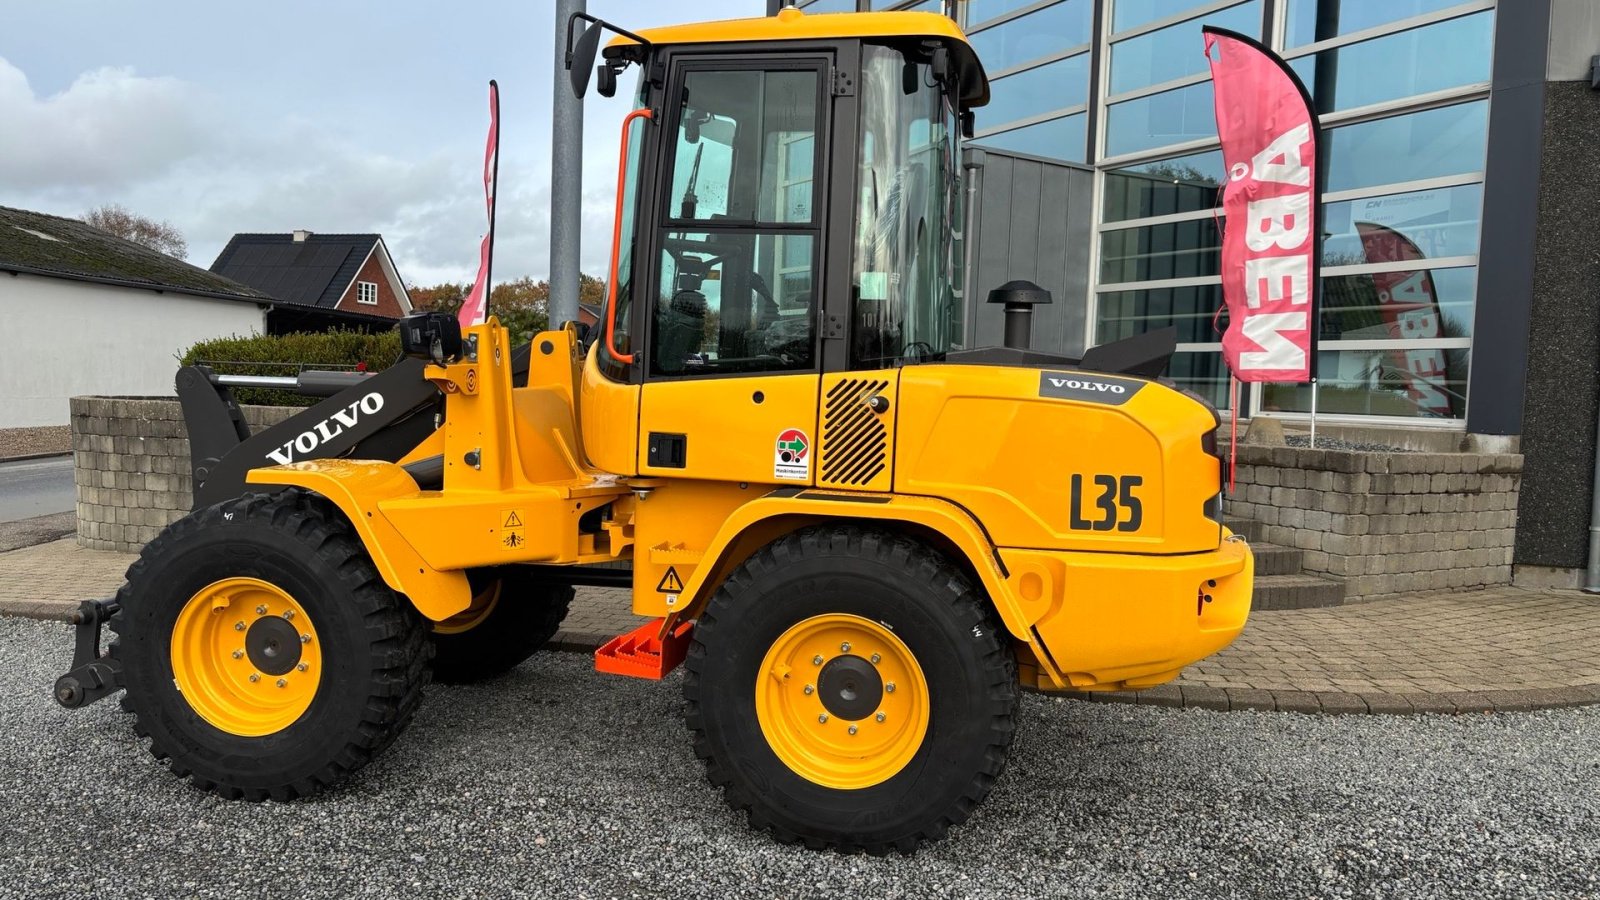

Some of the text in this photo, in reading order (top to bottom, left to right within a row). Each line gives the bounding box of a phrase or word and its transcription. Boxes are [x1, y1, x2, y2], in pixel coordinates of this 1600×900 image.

[1048, 377, 1126, 395] VOLVO
[265, 391, 385, 466] VOLVO
[1069, 473, 1143, 532] L35
